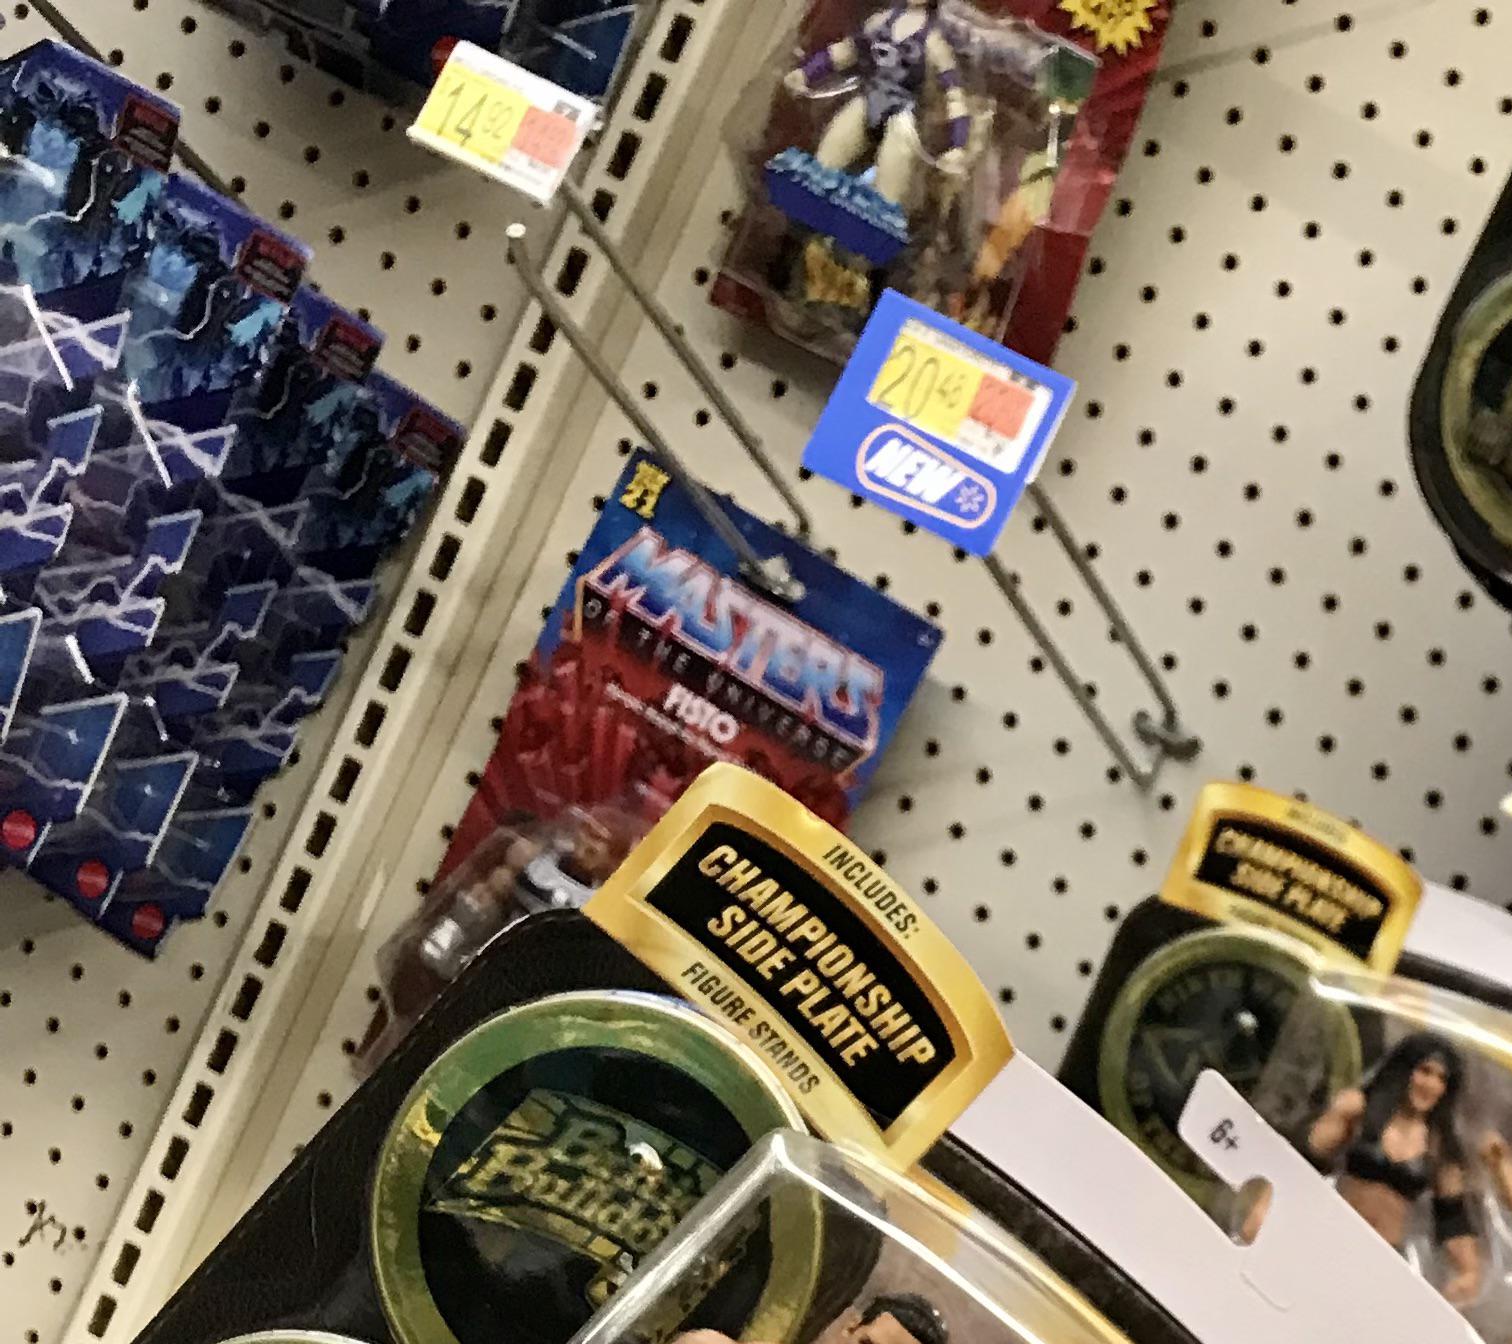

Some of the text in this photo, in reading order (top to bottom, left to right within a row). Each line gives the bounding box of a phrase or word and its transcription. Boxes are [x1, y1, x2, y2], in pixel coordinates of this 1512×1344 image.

[864, 437, 967, 505] NEW
[599, 525, 885, 747] MASTERS
[698, 844, 937, 1066] CHAMPIONSHIP
[822, 844, 920, 940] INCLUDES:
[681, 961, 821, 1096] FIGURE STANDS
[707, 904, 880, 1067] SIDE PLATE
[1208, 1118, 1241, 1152] 6+
